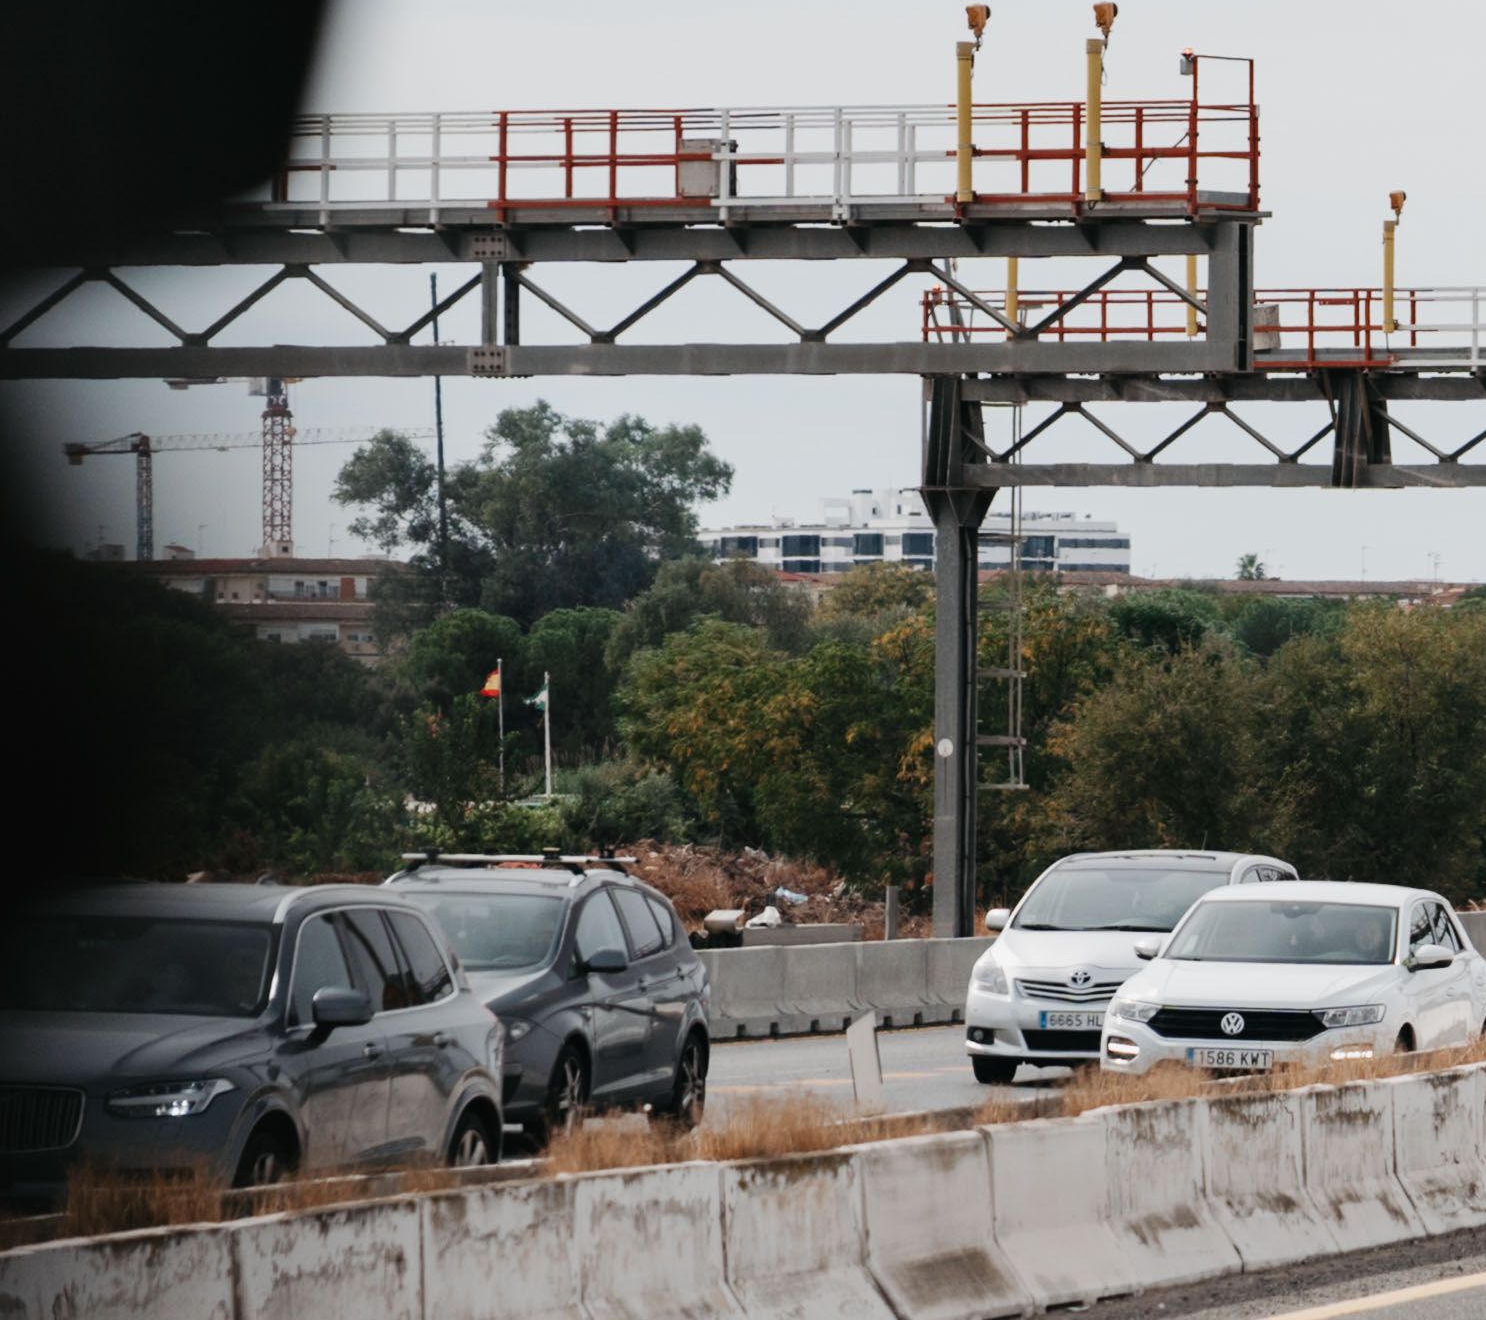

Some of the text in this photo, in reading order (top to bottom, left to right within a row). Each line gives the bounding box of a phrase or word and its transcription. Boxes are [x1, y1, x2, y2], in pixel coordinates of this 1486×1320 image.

[1050, 1013, 1103, 1026] 6665 HL
[1200, 1049, 1271, 1066] 1586 KWT
